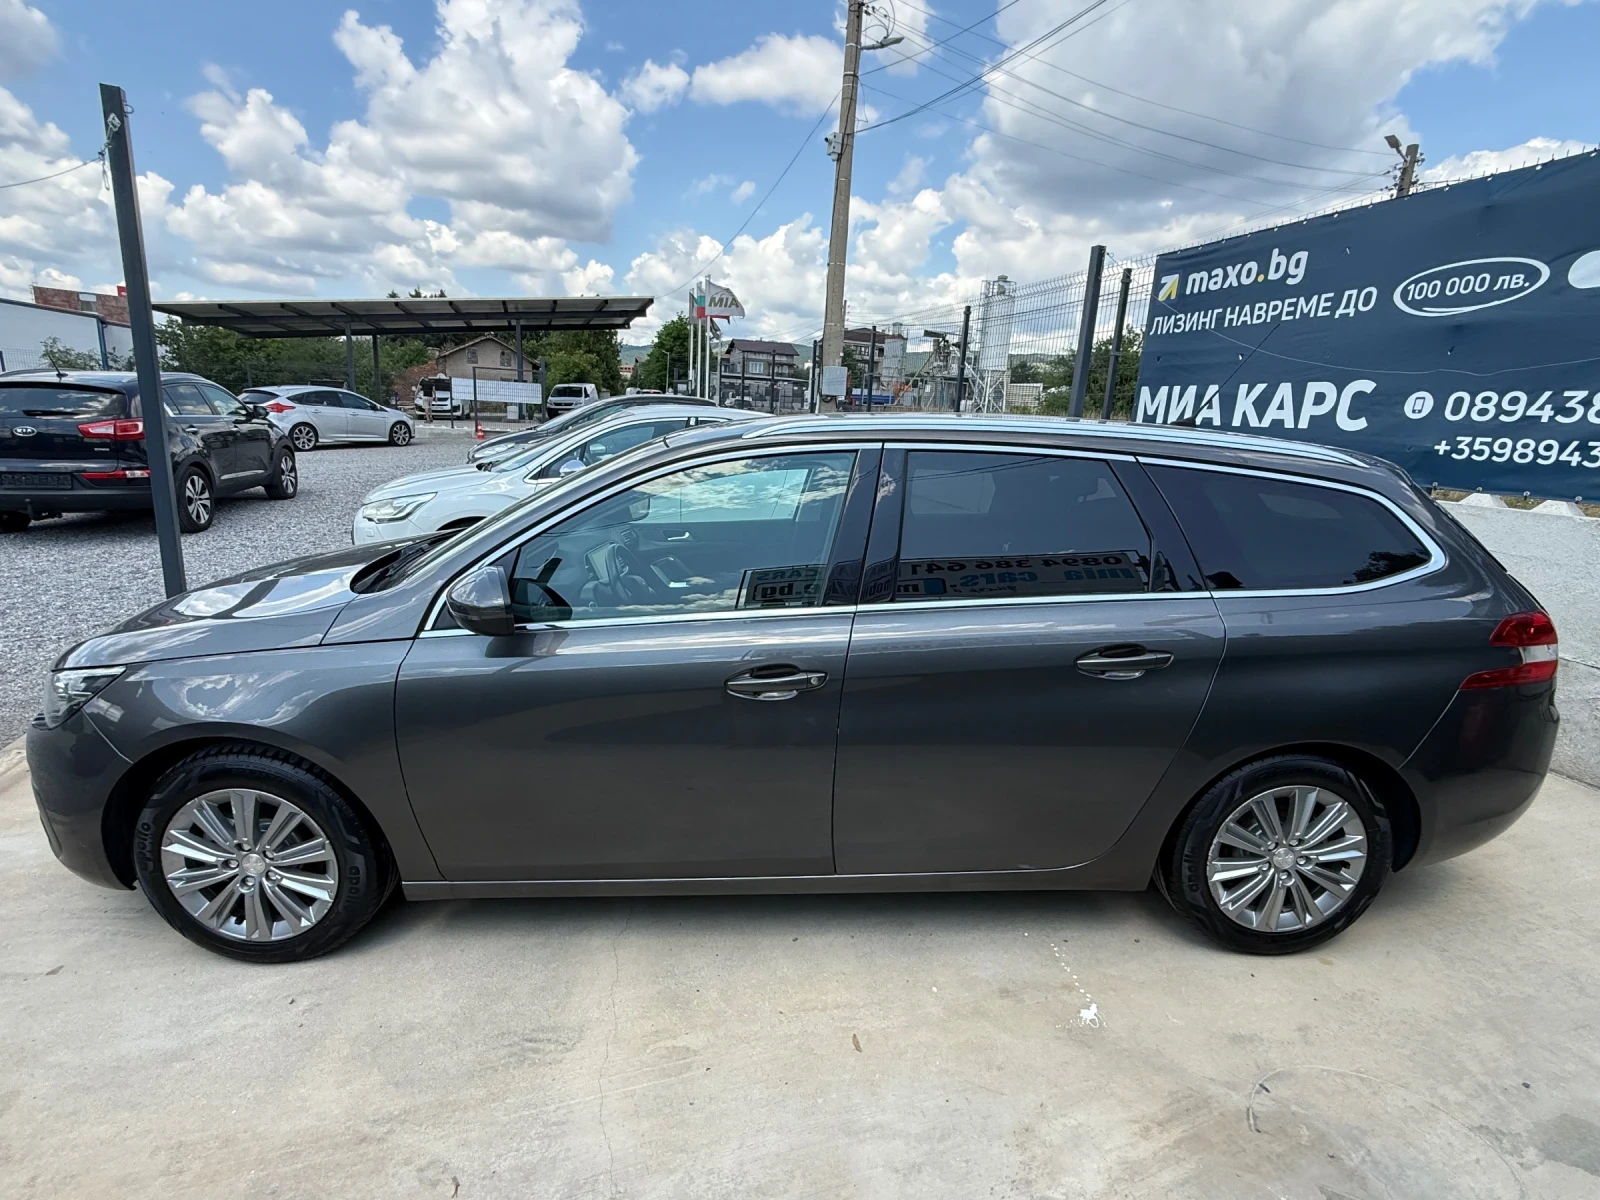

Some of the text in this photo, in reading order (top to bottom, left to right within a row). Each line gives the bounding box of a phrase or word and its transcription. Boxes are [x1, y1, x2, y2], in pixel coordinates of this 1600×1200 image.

[1185, 248, 1309, 295] maxo.bg
[1407, 273, 1530, 301] 100 000 лв.
[708, 296, 739, 308] MIA
[1149, 286, 1378, 336] ЛИЗИНГ НАВРЕМЕ ДО
[1136, 379, 1377, 432] МИА КАРС
[1434, 436, 1600, 468] +3598943
